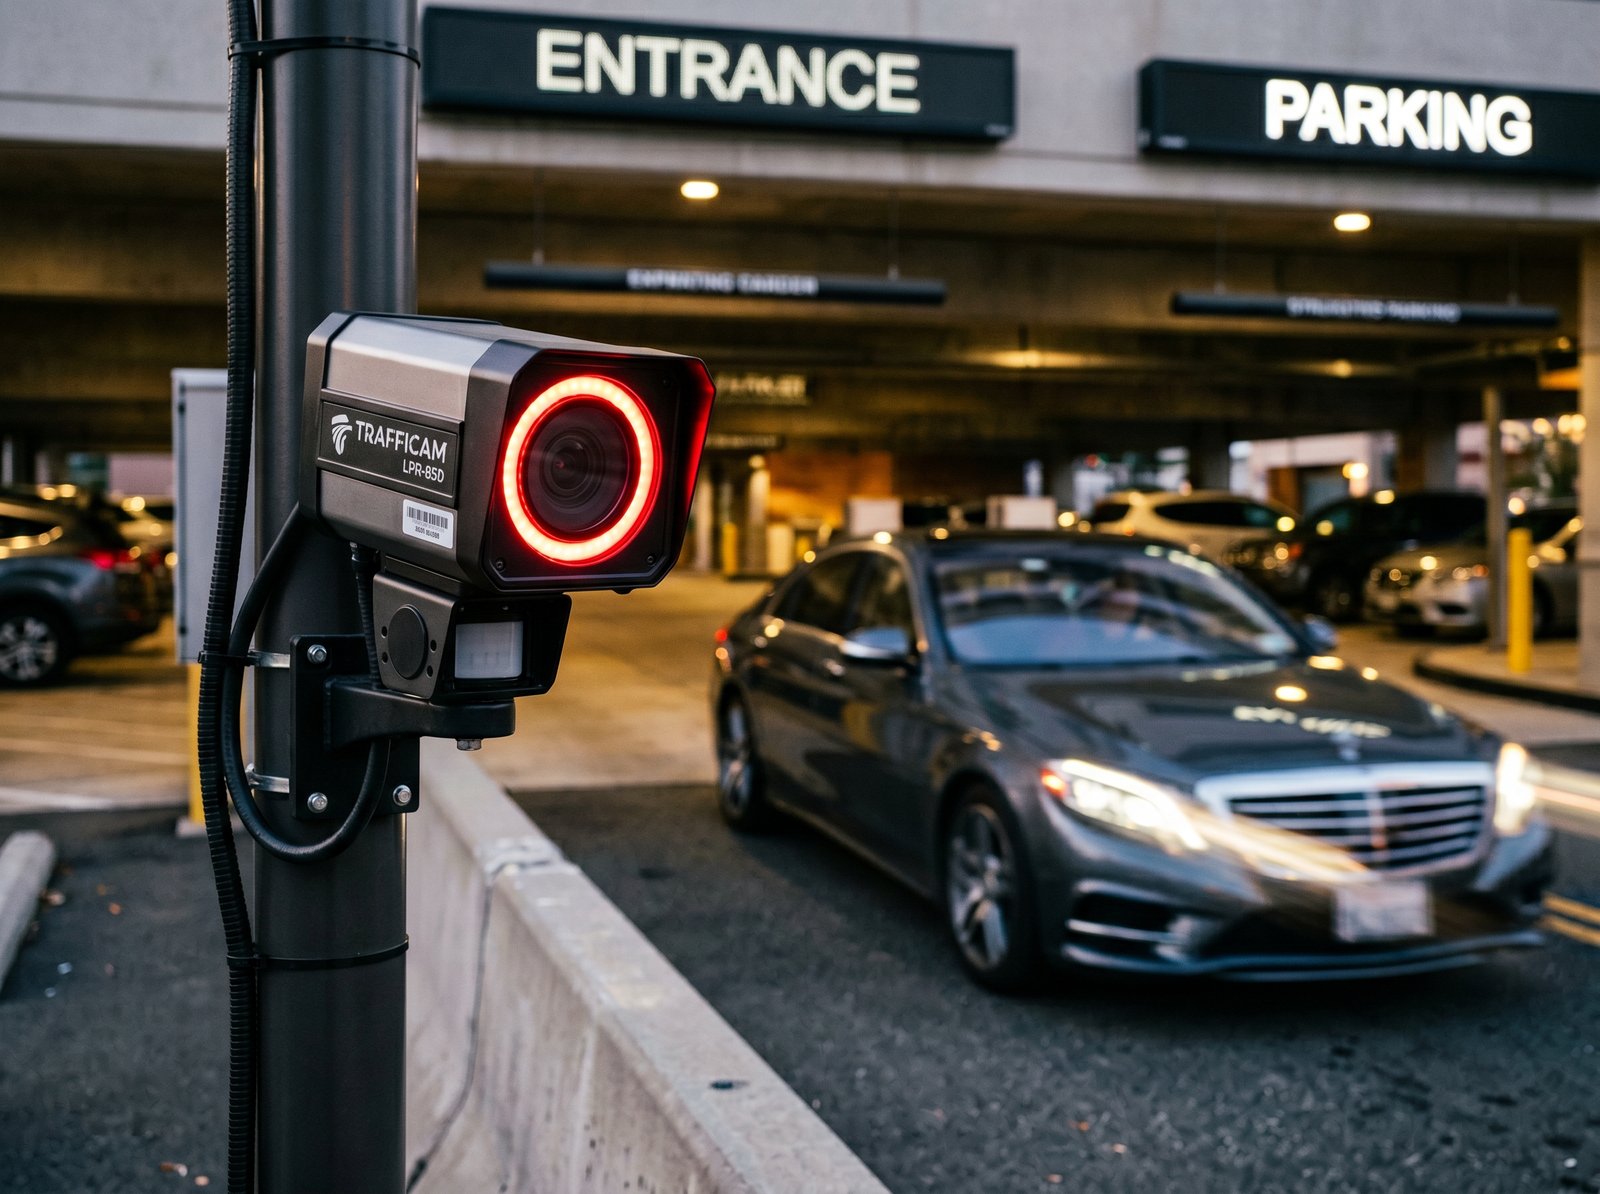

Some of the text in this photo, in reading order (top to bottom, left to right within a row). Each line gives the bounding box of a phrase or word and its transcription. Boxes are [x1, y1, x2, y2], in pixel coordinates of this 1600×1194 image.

[536, 28, 921, 113] ENTRANCE
[1265, 78, 1533, 156] PARKING
[355, 420, 448, 463] TRAFFICAM
[402, 459, 445, 483] LPR-85D
